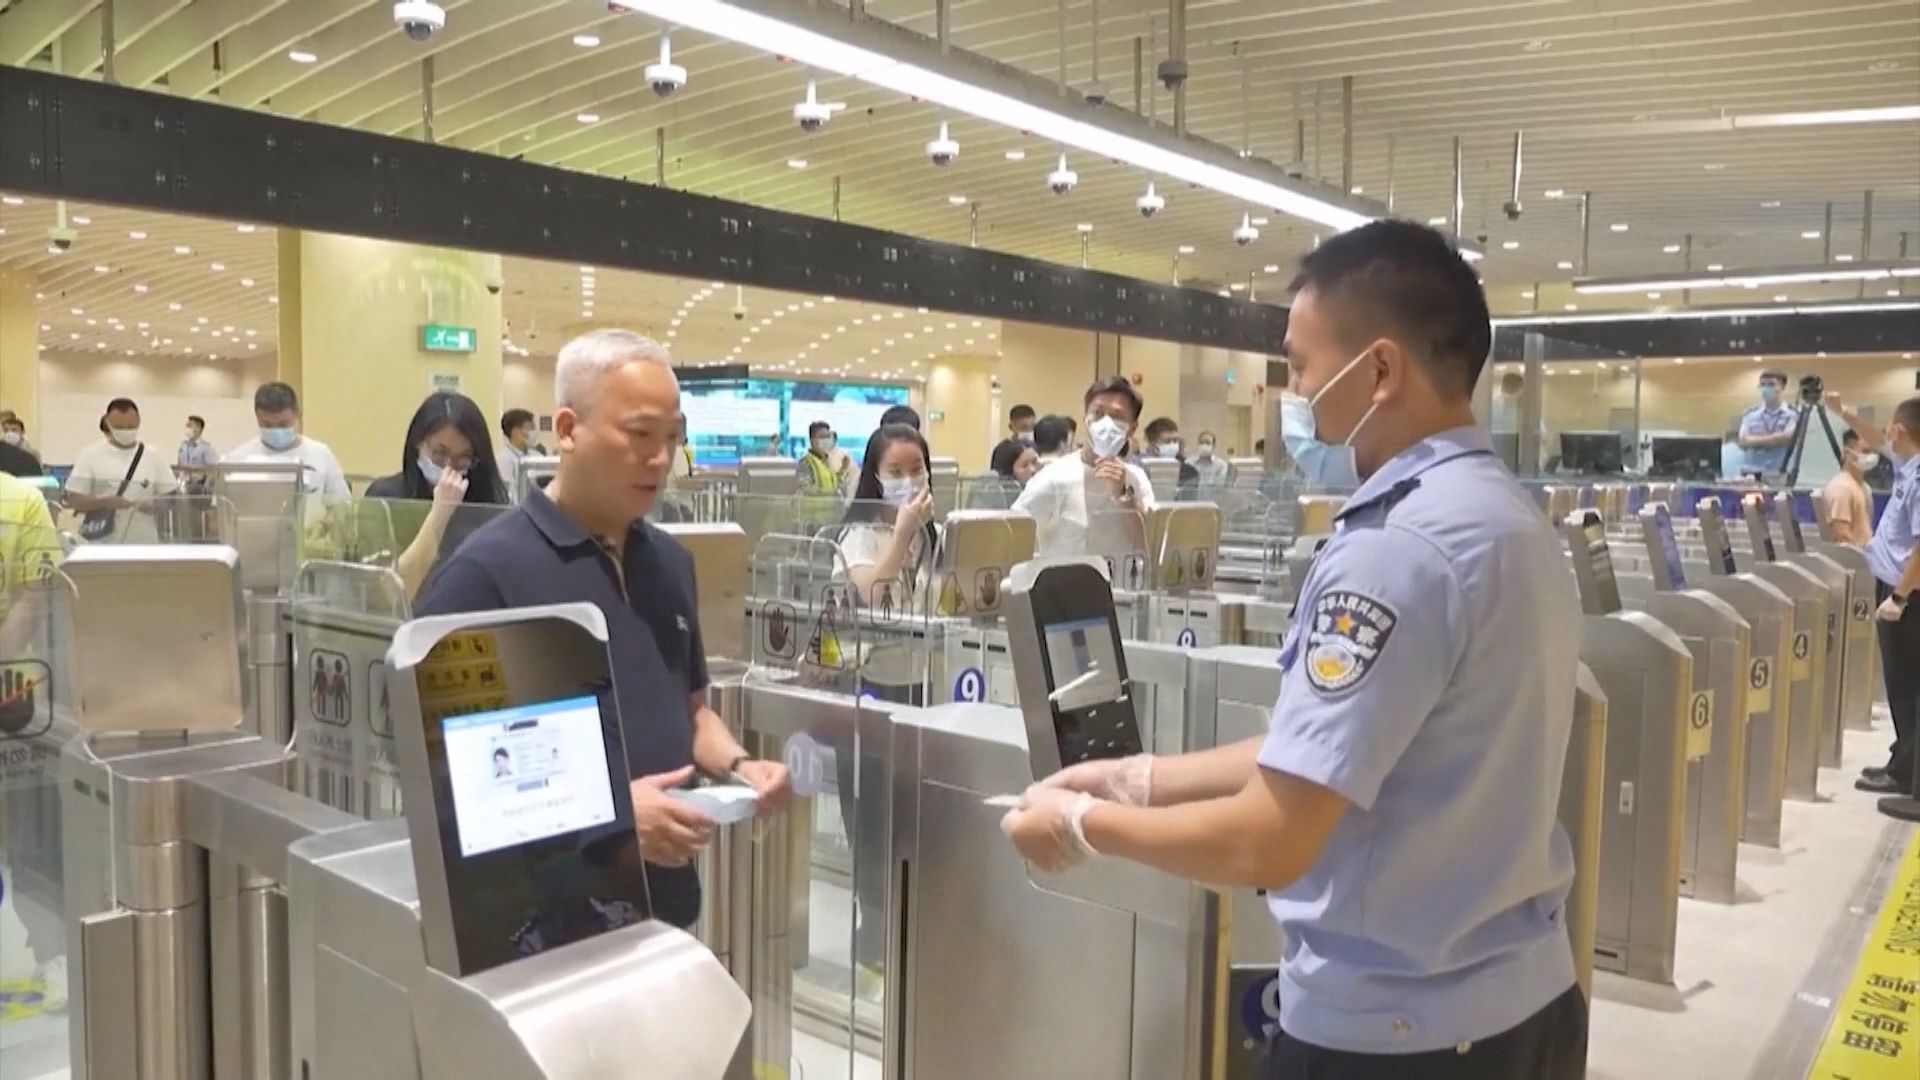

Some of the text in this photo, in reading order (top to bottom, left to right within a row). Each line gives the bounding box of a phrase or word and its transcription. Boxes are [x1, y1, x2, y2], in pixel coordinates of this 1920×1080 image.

[1794, 634, 1806, 658] 4
[961, 671, 980, 703] 9
[1753, 661, 1766, 687] 5
[1694, 697, 1707, 728] 6
